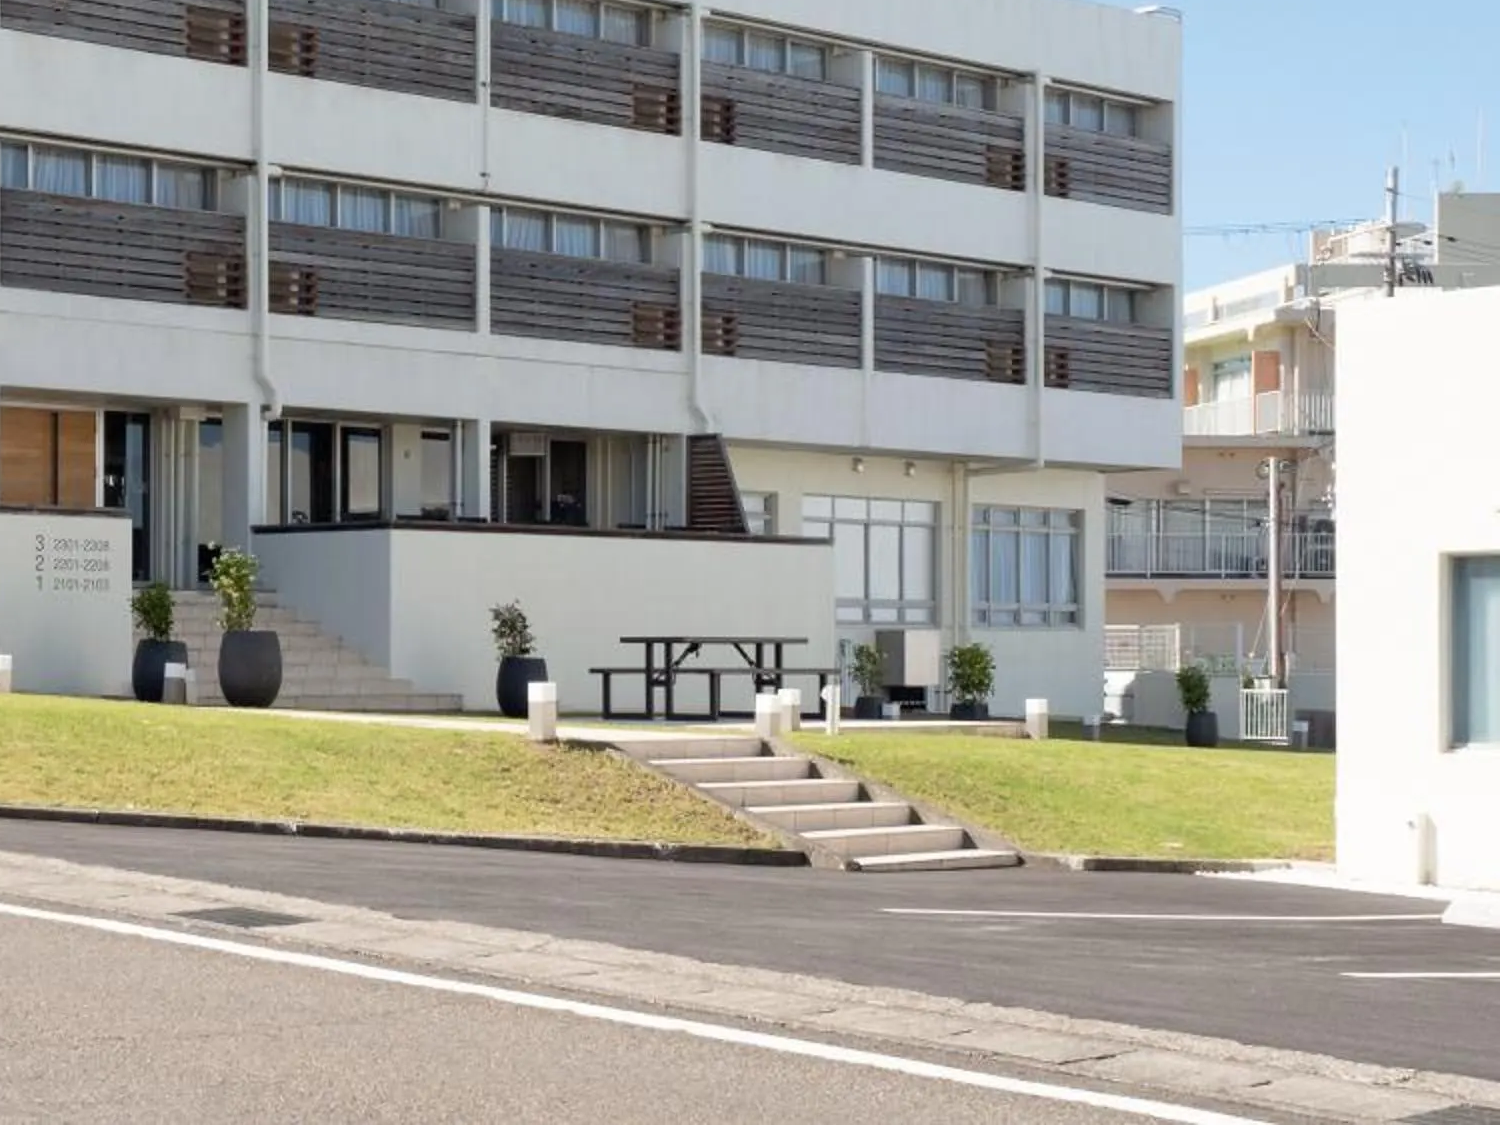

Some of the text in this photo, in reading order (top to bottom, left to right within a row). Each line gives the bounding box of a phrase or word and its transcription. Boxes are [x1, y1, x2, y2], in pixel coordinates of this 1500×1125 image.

[35, 534, 45, 552] 3
[35, 554, 44, 572] 2
[35, 575, 44, 591] 1
